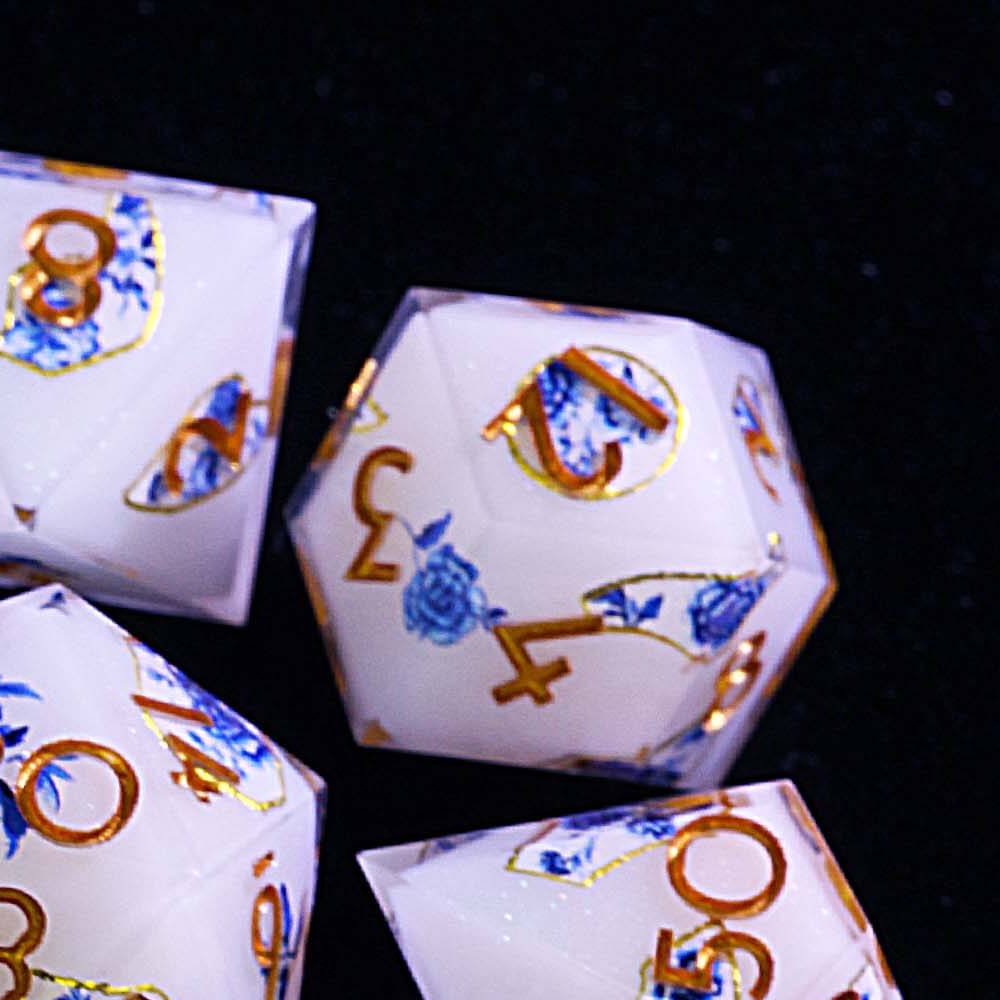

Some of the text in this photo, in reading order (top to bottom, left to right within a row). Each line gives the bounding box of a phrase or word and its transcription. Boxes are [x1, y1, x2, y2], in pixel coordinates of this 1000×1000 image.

[20, 208, 118, 328] 8
[481, 346, 670, 500] 12
[491, 614, 604, 707] 4
[130, 693, 241, 803] 14
